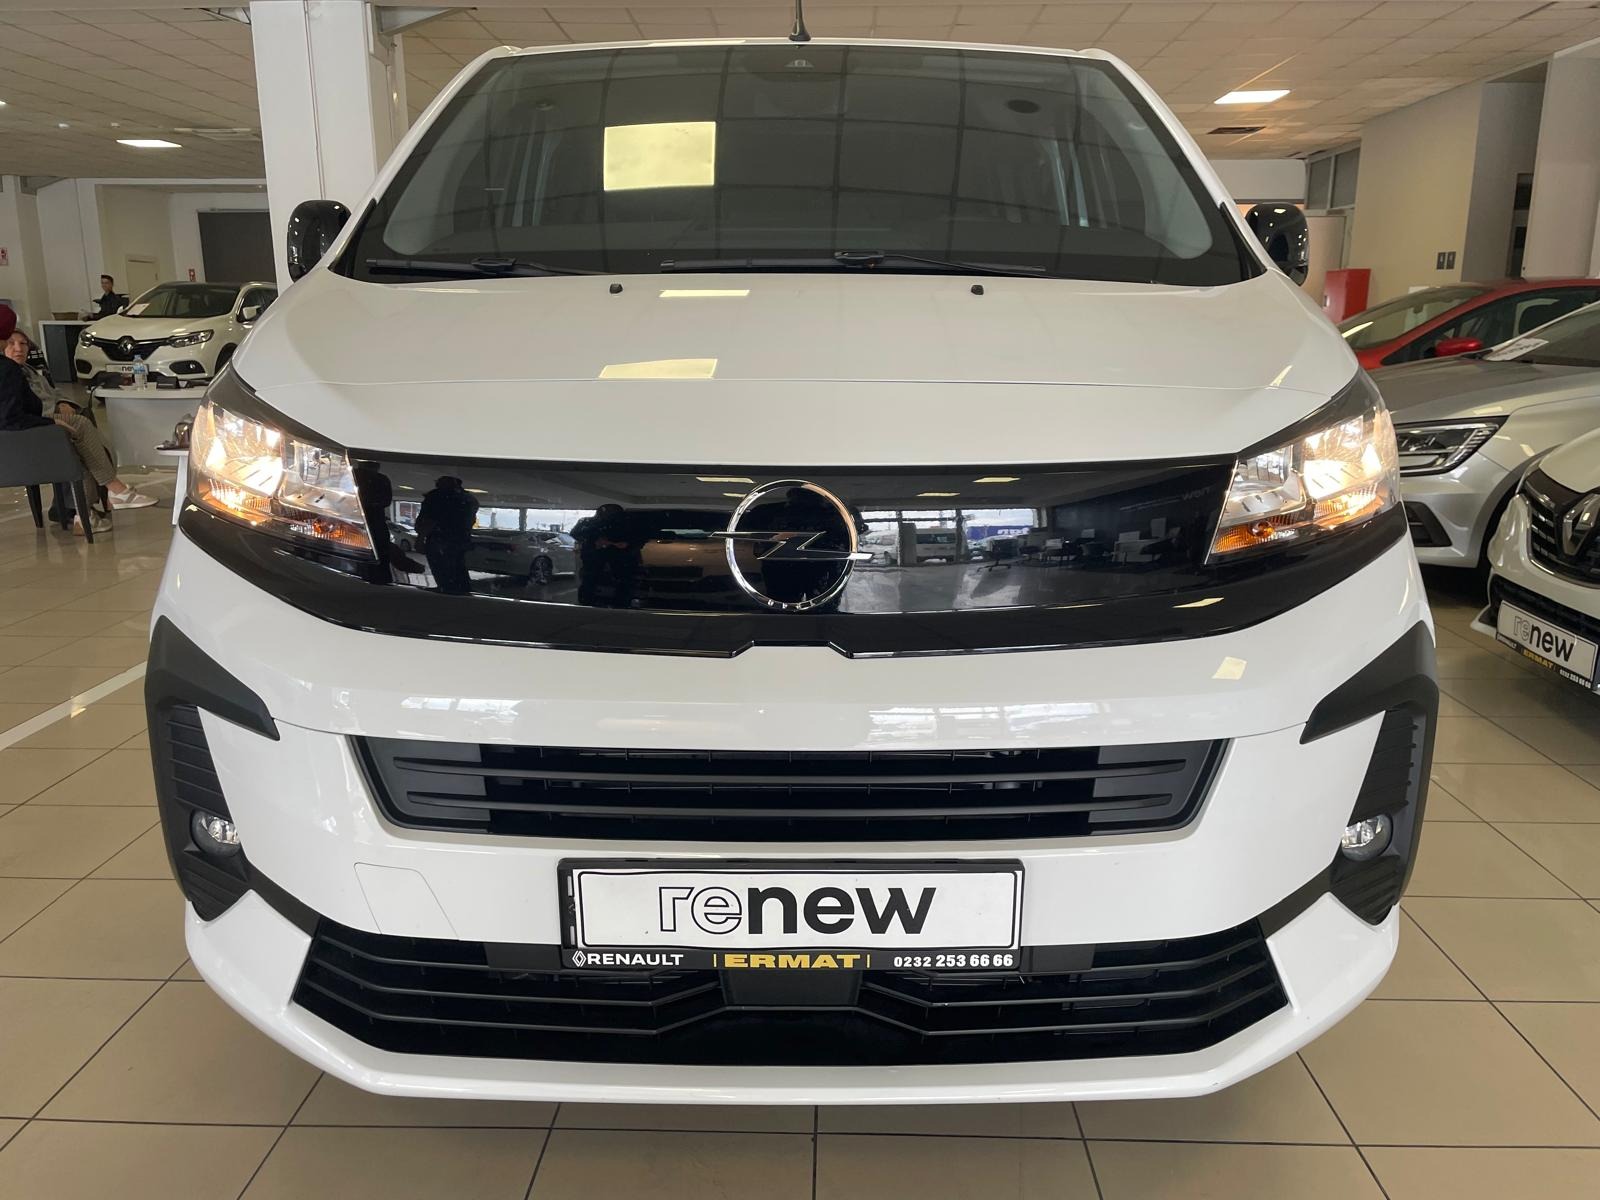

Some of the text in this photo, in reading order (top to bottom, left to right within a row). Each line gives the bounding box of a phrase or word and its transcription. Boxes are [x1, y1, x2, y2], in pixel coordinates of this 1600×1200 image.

[1513, 615, 1574, 662] renew
[659, 886, 937, 935] renew
[587, 953, 684, 966] RENAULT
[724, 953, 861, 968] ERMAT
[893, 954, 1014, 968] 0232 253 66 66
